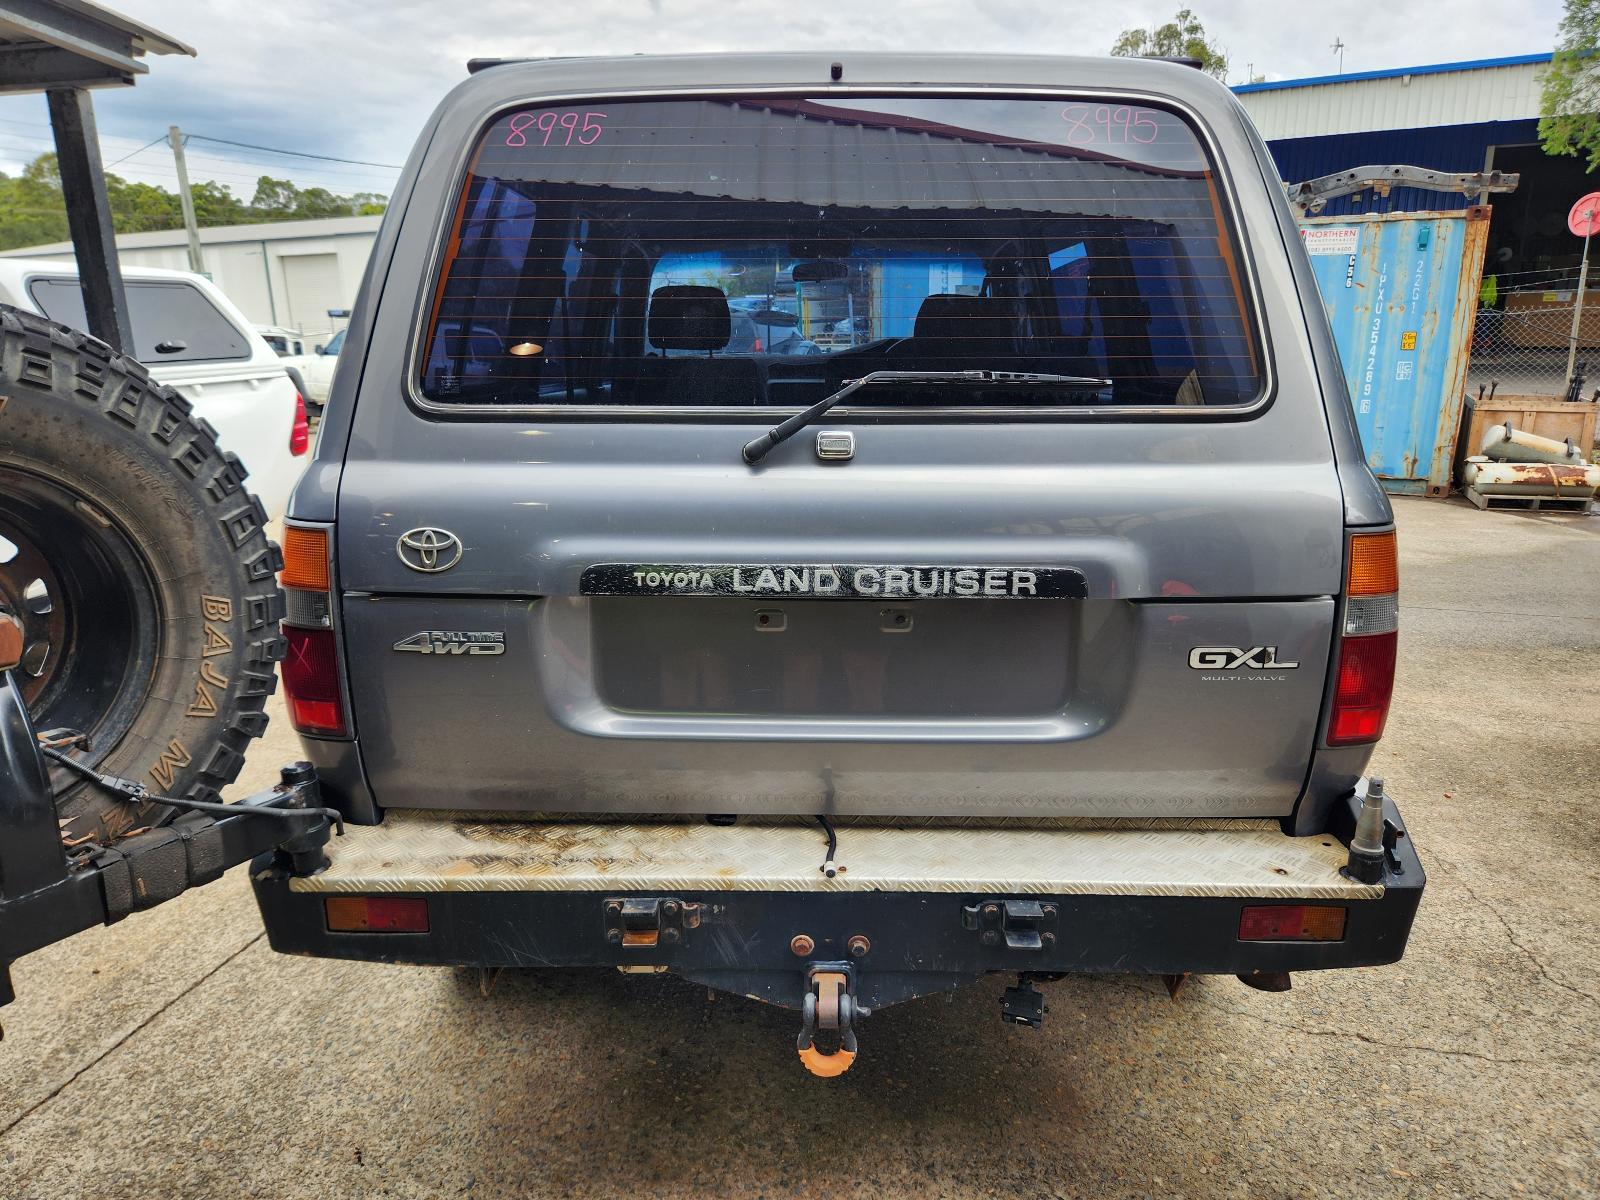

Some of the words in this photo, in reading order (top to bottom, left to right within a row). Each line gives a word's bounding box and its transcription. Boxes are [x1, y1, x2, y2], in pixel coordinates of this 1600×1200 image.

[505, 112, 608, 147] 8995
[1062, 105, 1158, 144] 8995
[1308, 230, 1357, 238] NORTHERN
[1346, 255, 1356, 287] C56
[1364, 318, 1381, 396] 354289
[633, 571, 714, 588] TOYOTA
[733, 568, 840, 593] LAND
[854, 568, 1038, 596] CRUISER
[186, 594, 232, 718] BAJA
[393, 631, 505, 655] 4WD
[1189, 645, 1300, 669] GXL
